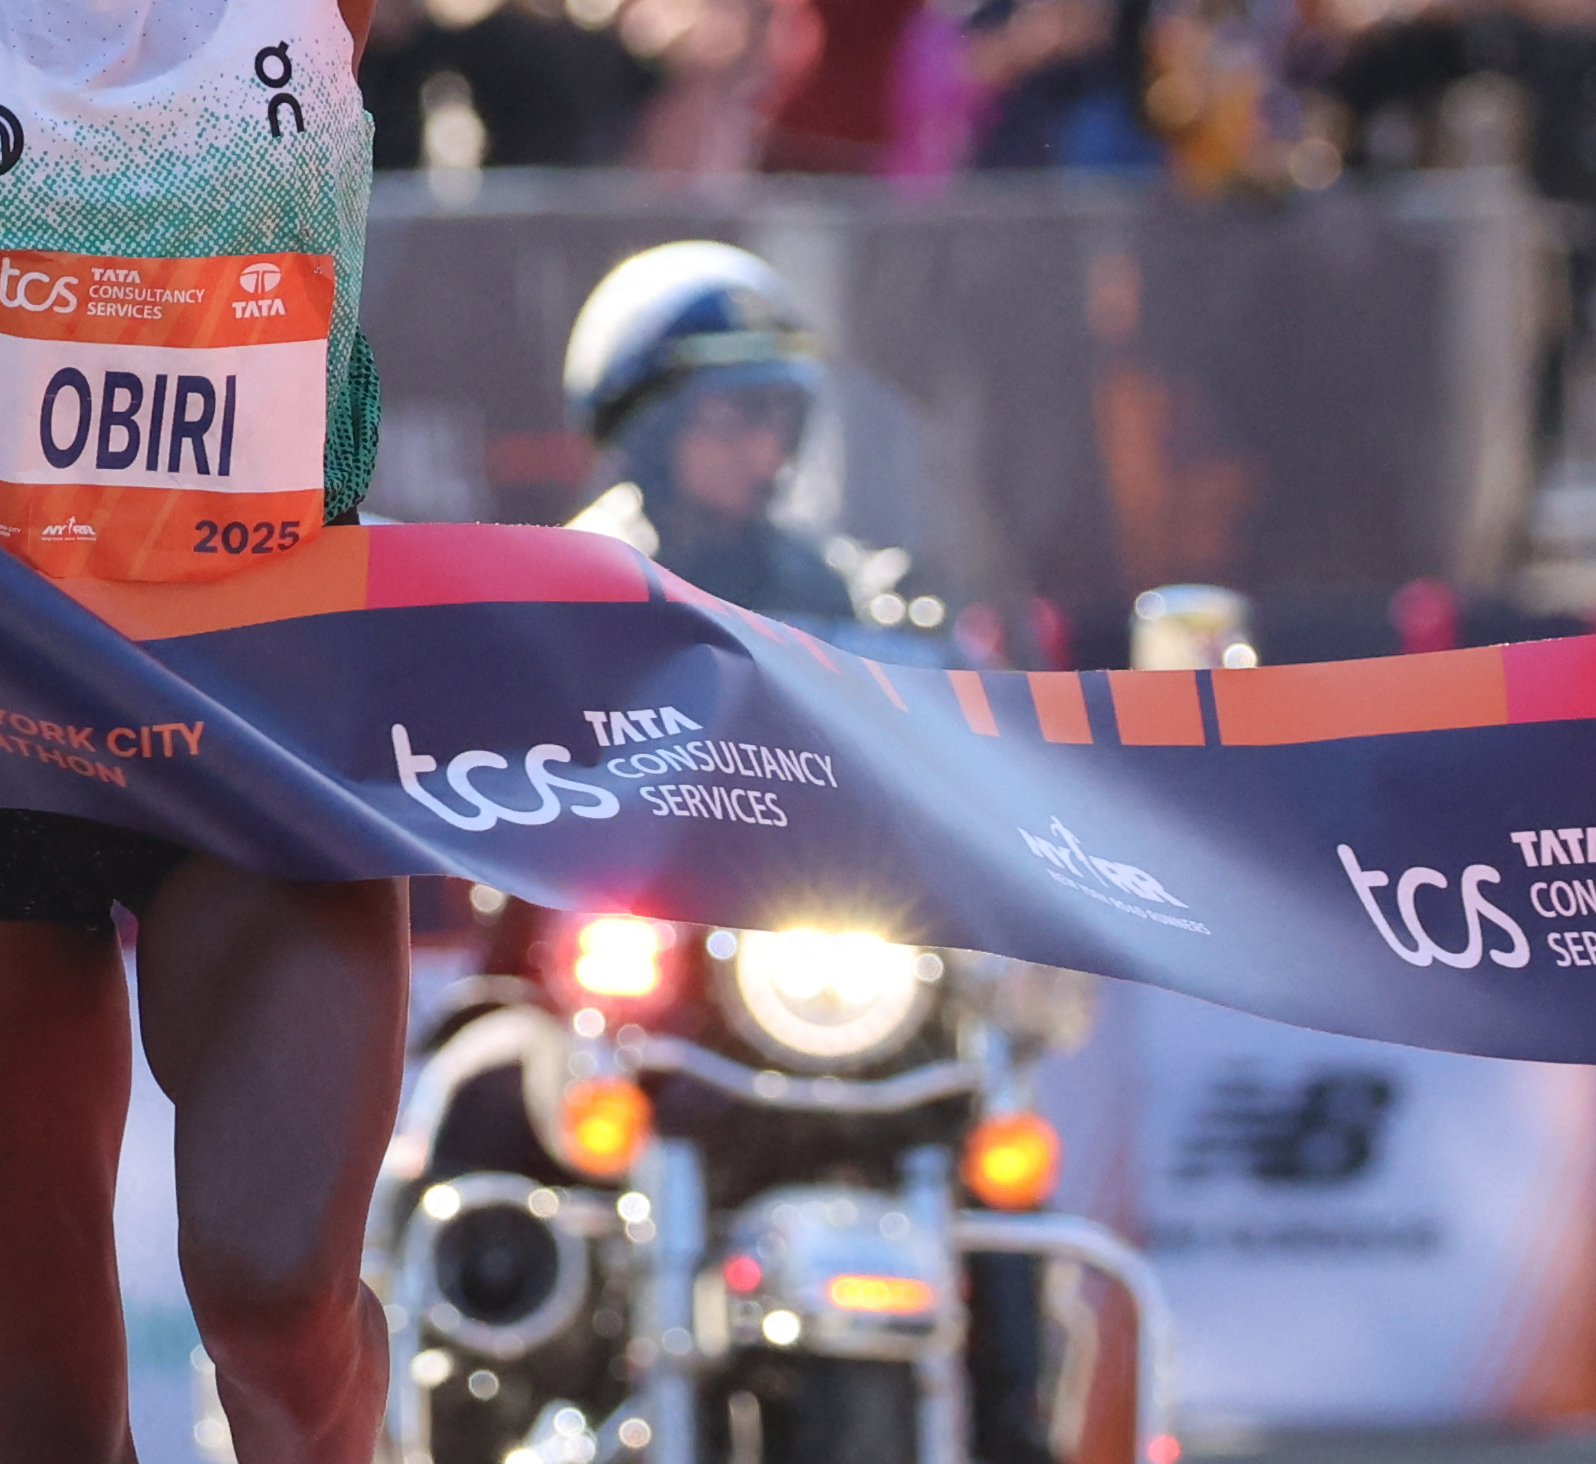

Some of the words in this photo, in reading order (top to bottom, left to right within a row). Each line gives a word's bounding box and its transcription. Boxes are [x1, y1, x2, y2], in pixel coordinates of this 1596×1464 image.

[89, 285, 205, 303] CONSULTANCY
[91, 268, 140, 284] TATA
[87, 302, 162, 319] SERVICES
[232, 298, 286, 319] TATA
[39, 367, 237, 476] OBIRI
[193, 520, 300, 554] 2025
[106, 721, 204, 759] CITY
[583, 706, 703, 747] TATA
[391, 723, 620, 832] tcs
[607, 740, 838, 789] CONSULTANCY
[639, 784, 788, 828] SERVICES
[1337, 844, 1531, 969] tcs
